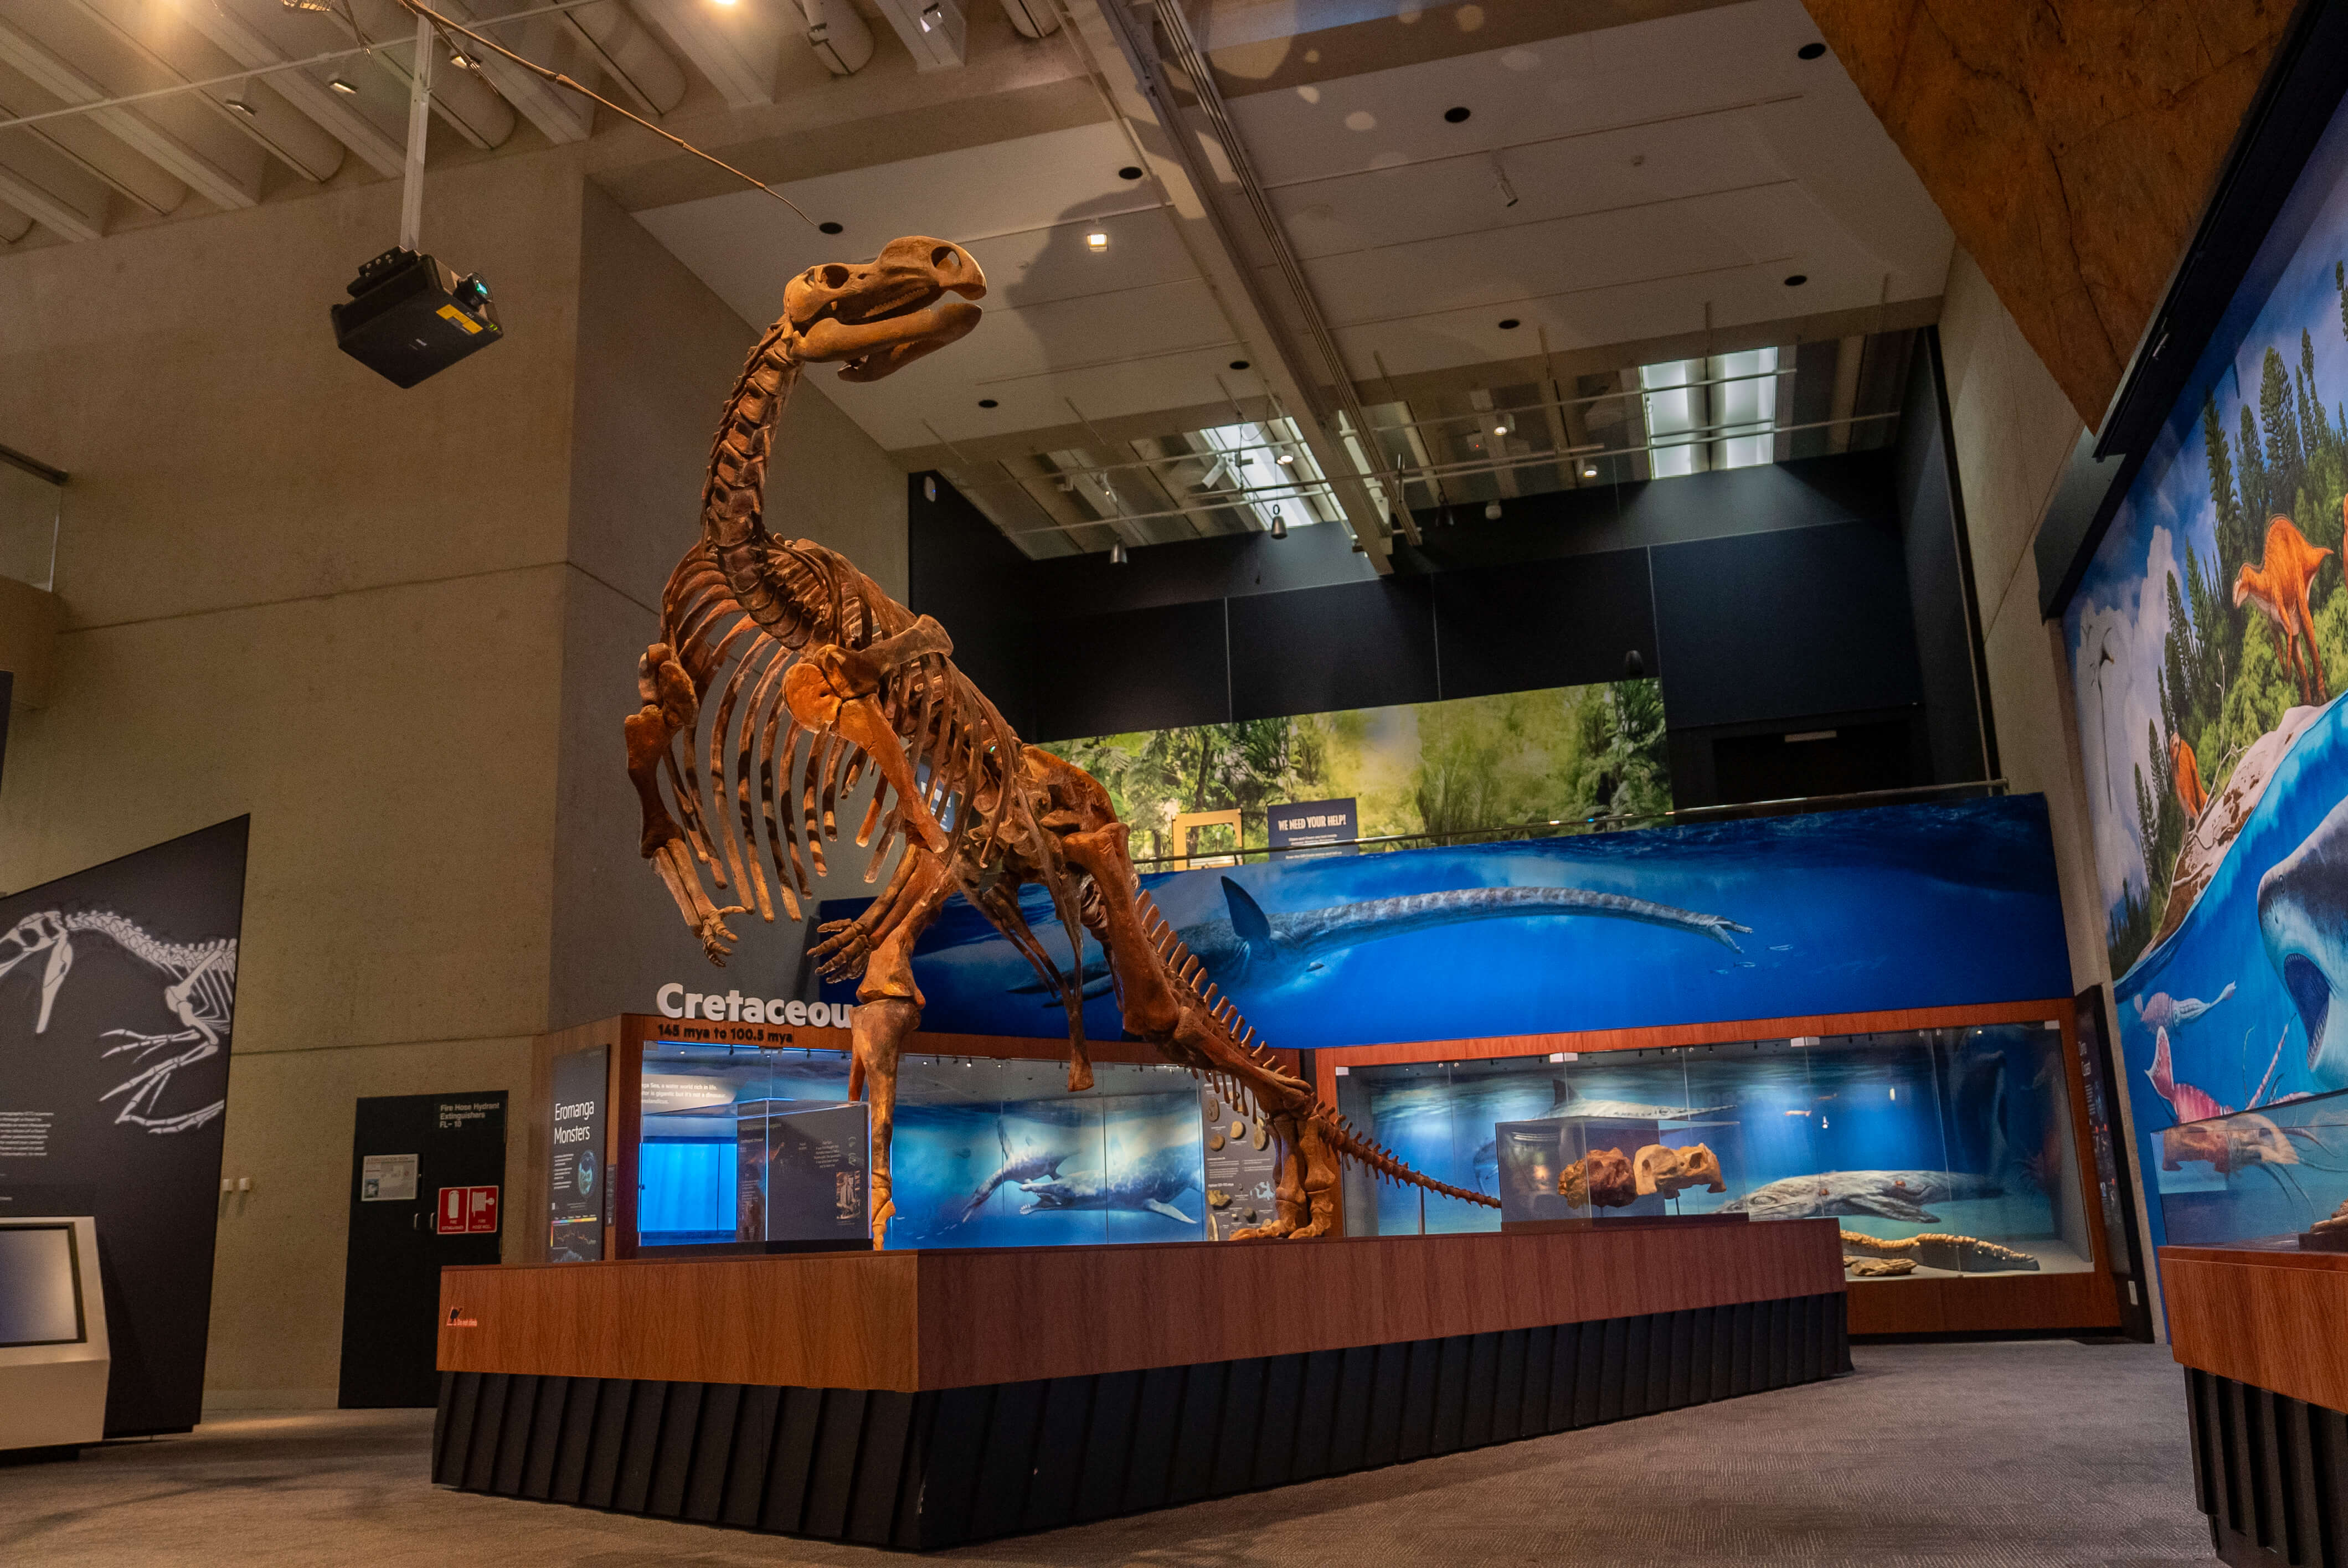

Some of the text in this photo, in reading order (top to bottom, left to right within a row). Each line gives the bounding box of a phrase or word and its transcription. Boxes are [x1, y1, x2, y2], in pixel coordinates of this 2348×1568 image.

[1278, 814, 1346, 831] WE NEED YOUR HELP!
[657, 983, 853, 1029] Cretaceou
[658, 1024, 793, 1045] 145 mya to 100.5 mya
[555, 1101, 594, 1121] Eromanga
[554, 1125, 590, 1145] Monsters
